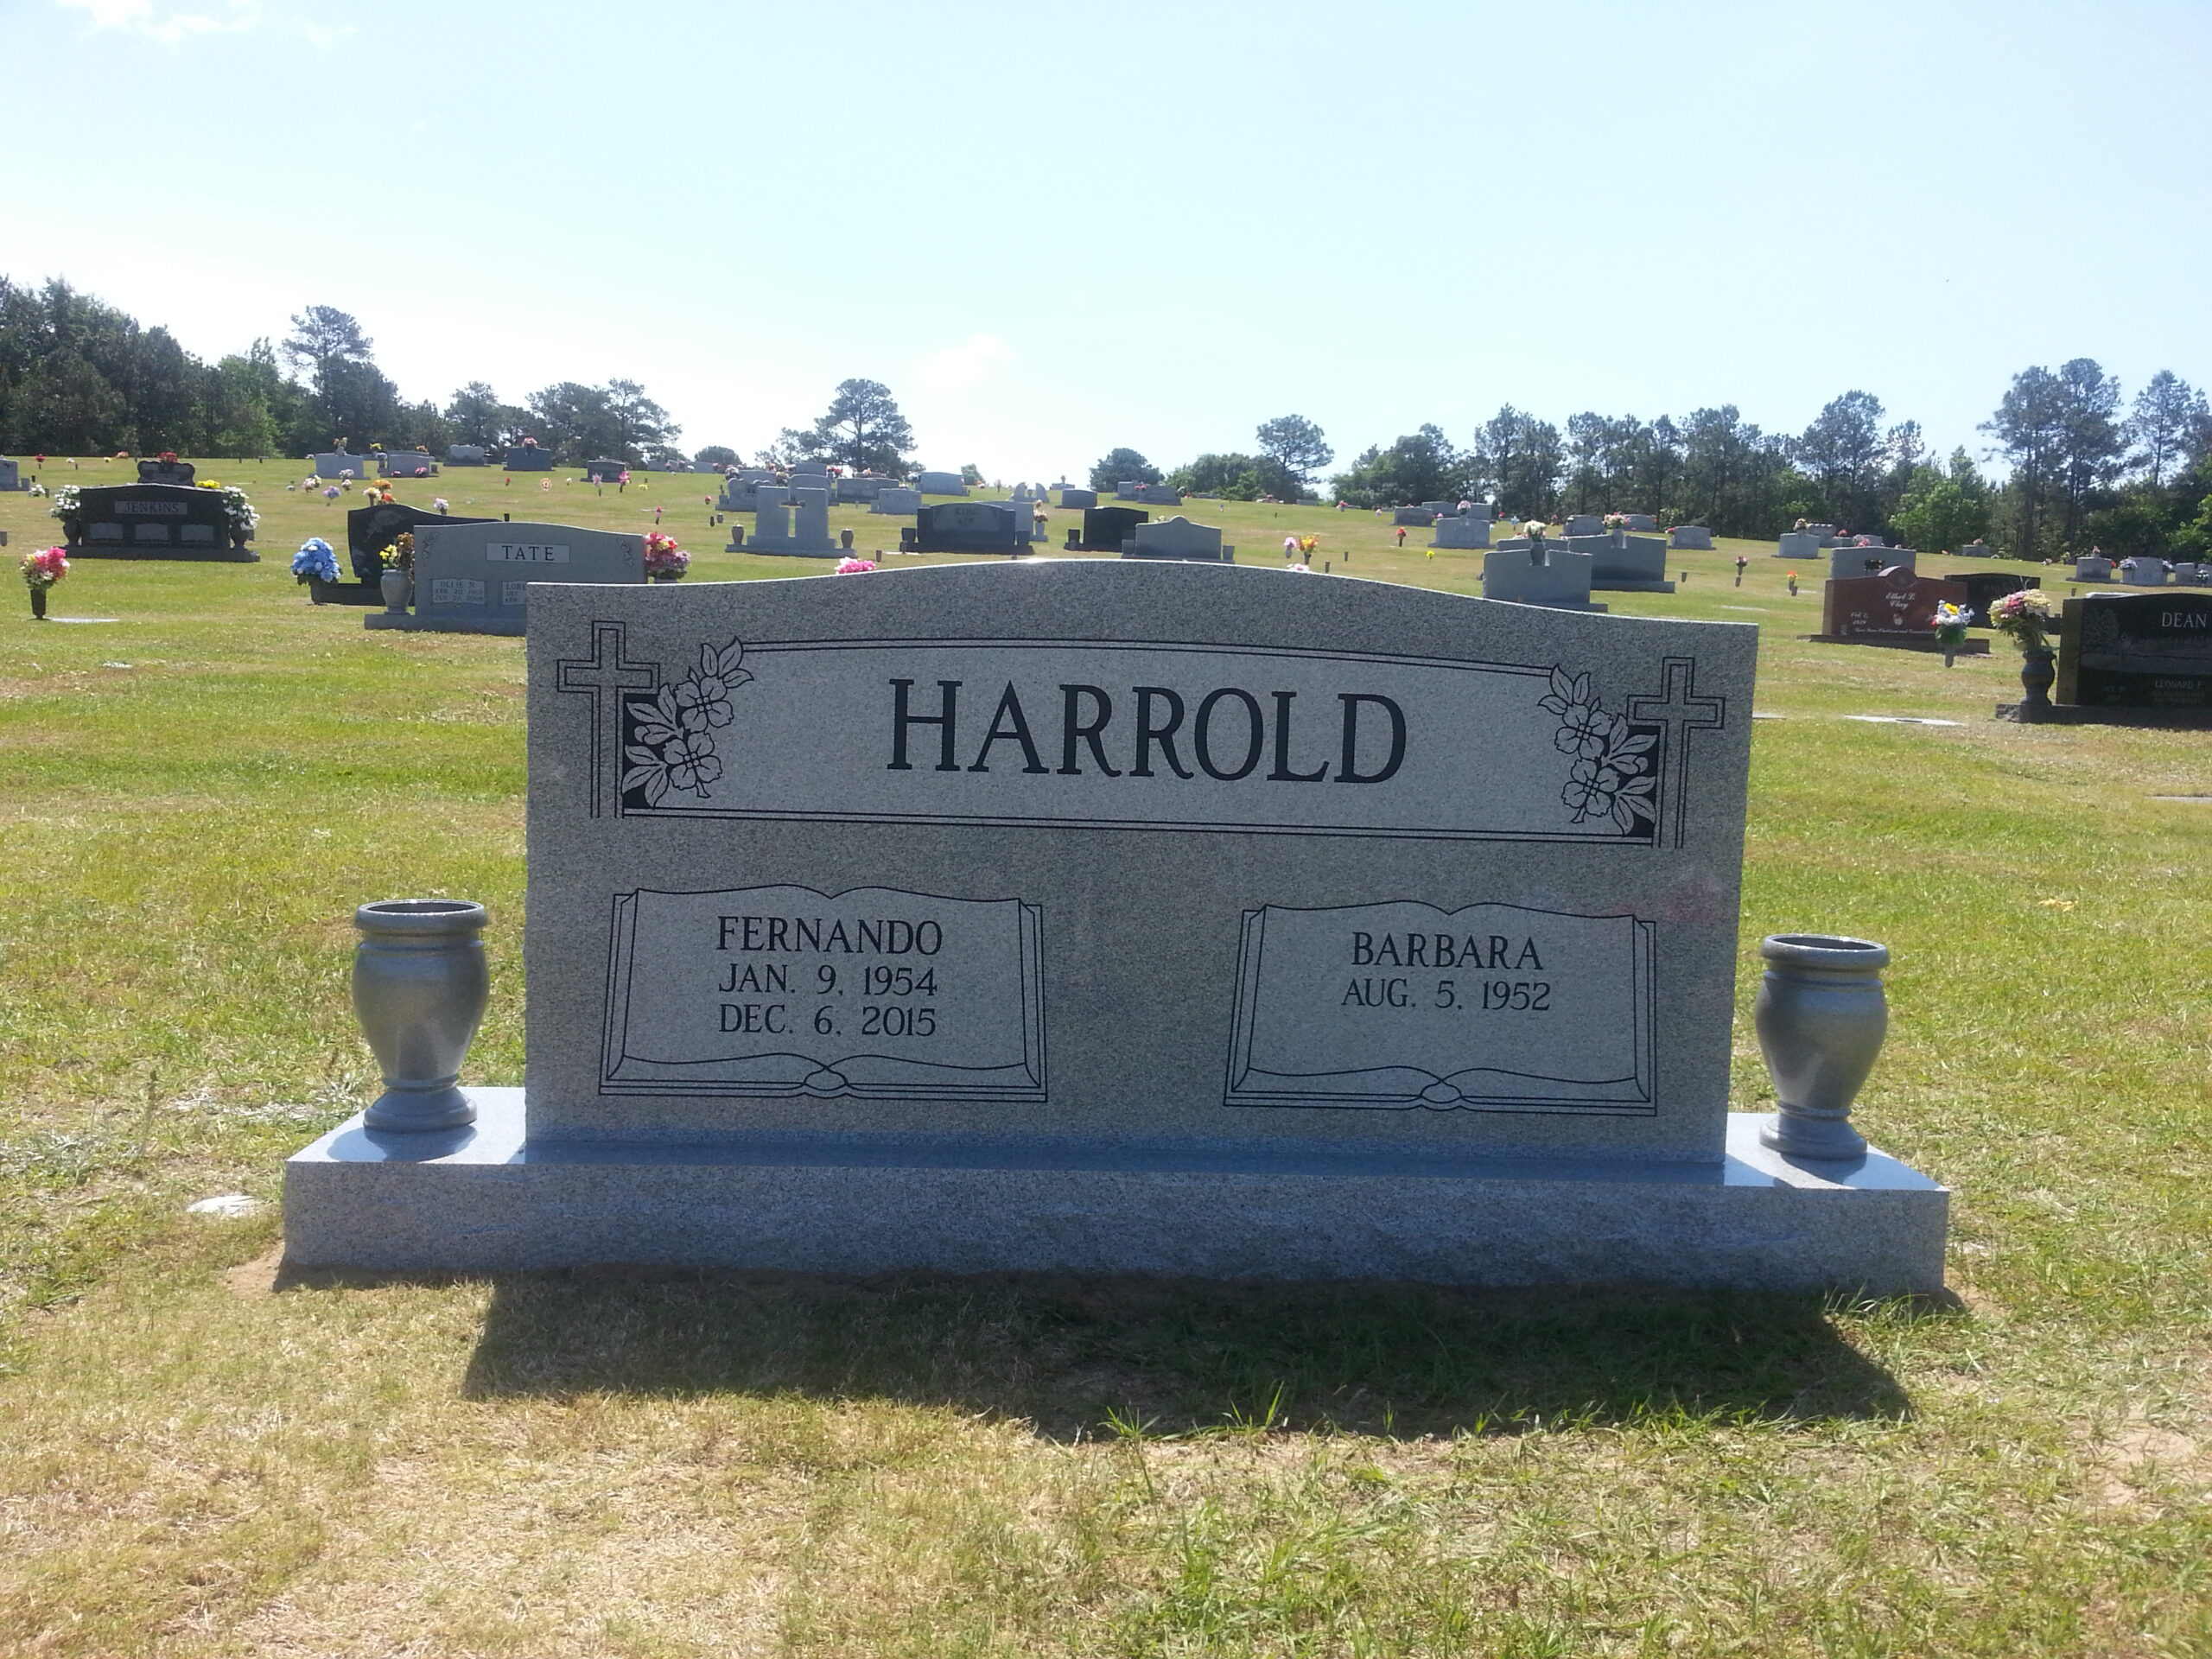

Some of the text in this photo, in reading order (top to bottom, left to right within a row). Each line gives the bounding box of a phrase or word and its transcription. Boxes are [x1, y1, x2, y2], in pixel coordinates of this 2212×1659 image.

[124, 501, 180, 513] JENKINS
[501, 545, 555, 562] TATE
[1890, 600, 1909, 610] Clay
[2162, 612, 2207, 628] DEAN
[887, 678, 1408, 784] HARROLD
[716, 916, 943, 956] FERNANDO
[1351, 931, 1543, 970] BARBARA
[718, 963, 938, 996] JAN. 9, 1954
[1341, 978, 1417, 1007] AUG.
[1482, 981, 1551, 1011] 1952
[719, 1004, 936, 1037] DEC. 6, 2015
